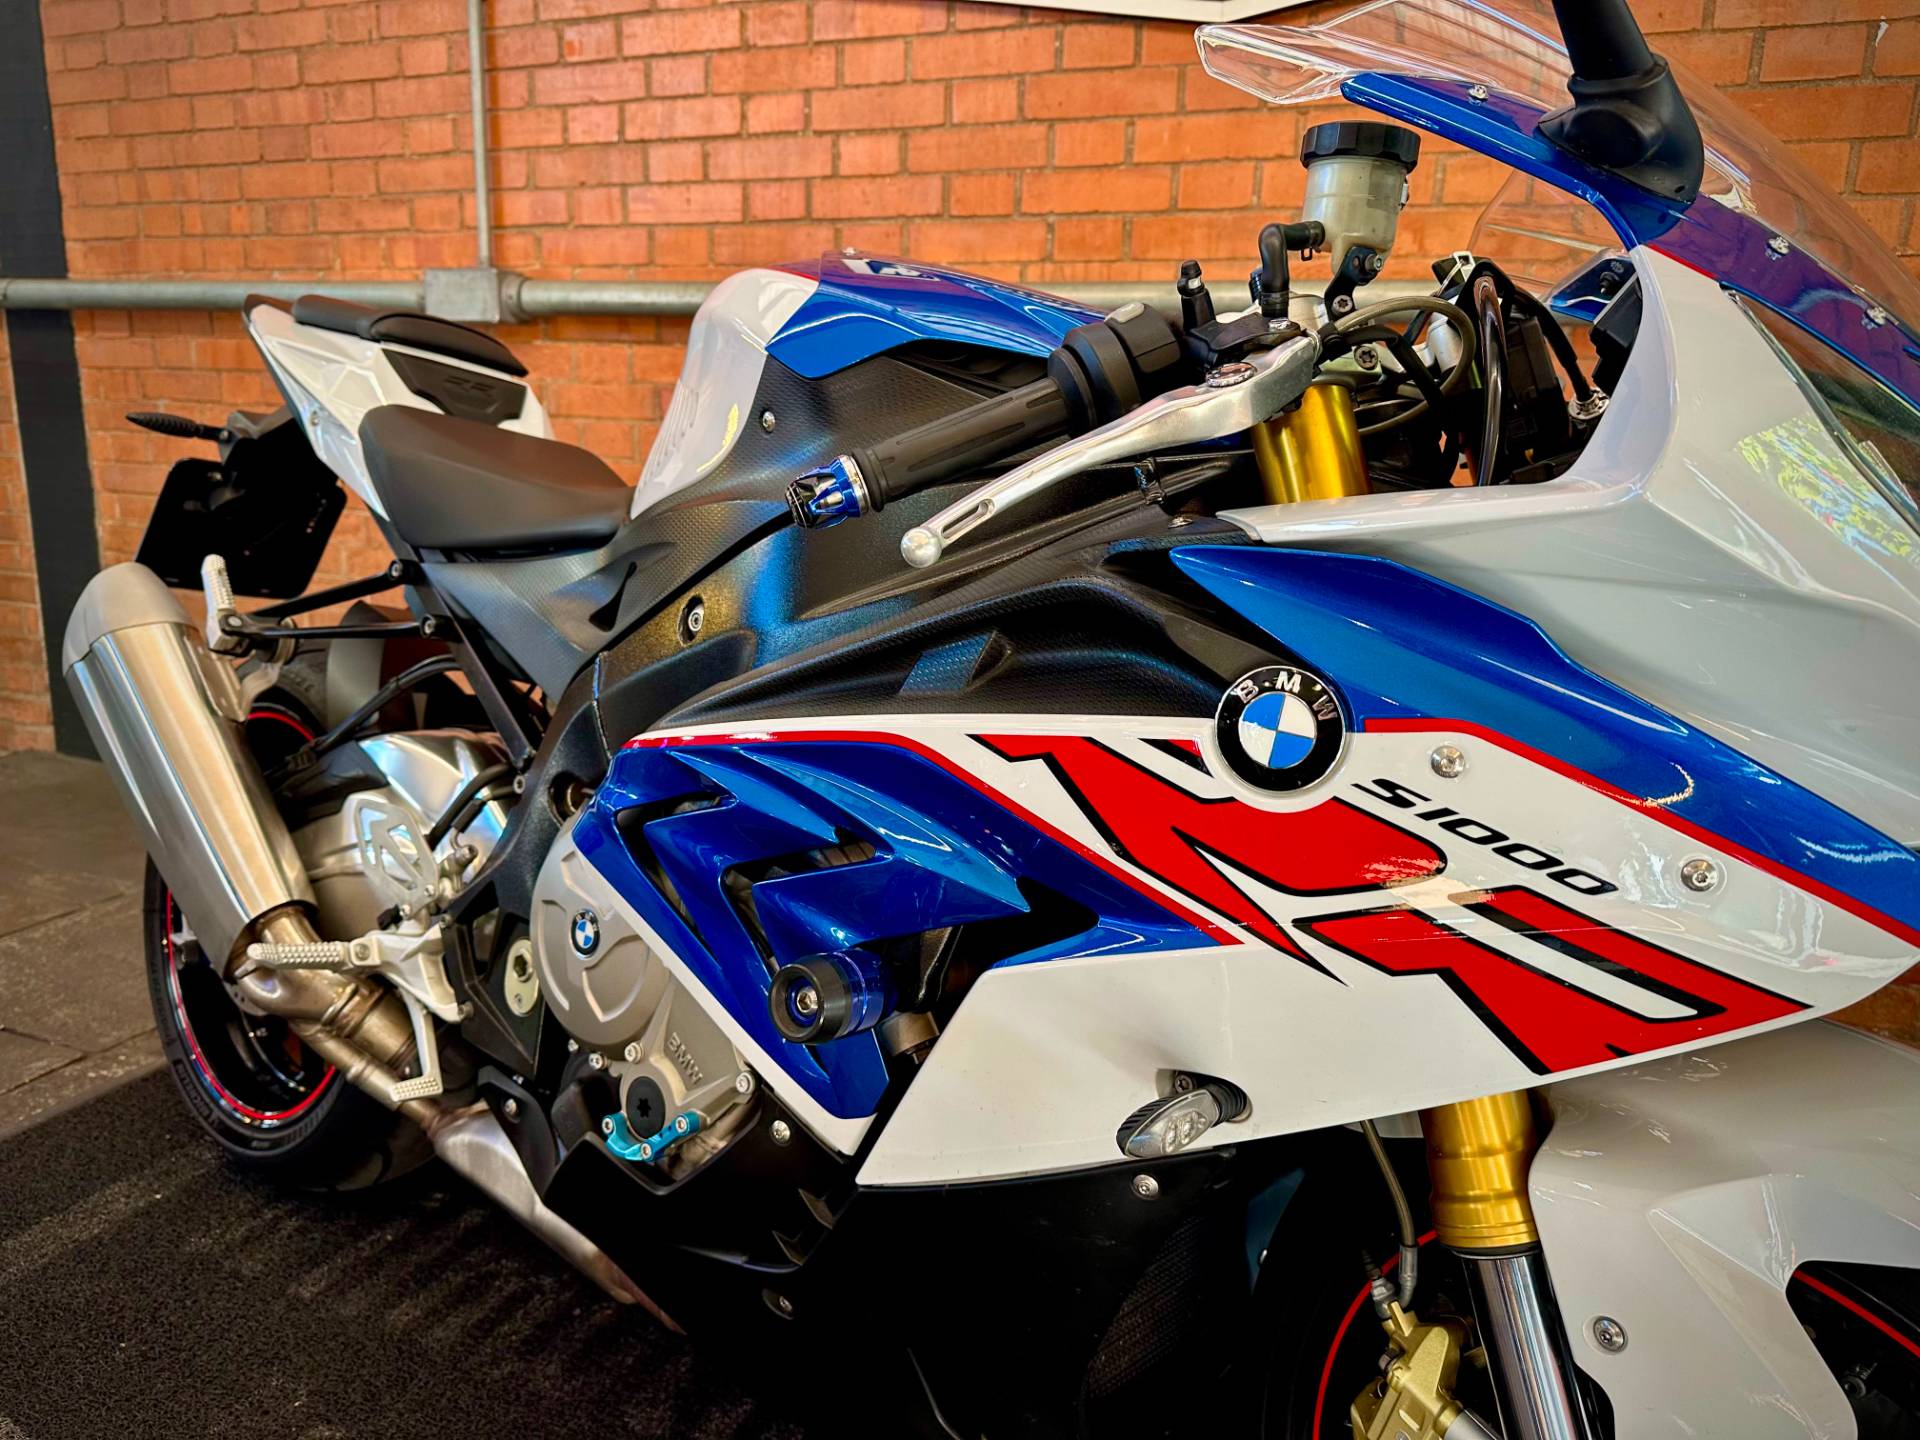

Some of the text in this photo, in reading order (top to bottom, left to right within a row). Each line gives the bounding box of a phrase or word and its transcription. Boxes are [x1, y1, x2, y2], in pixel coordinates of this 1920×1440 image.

[1233, 670, 1338, 721] BMW
[1350, 777, 1619, 896] S1000
[668, 1031, 704, 1085] BMW
